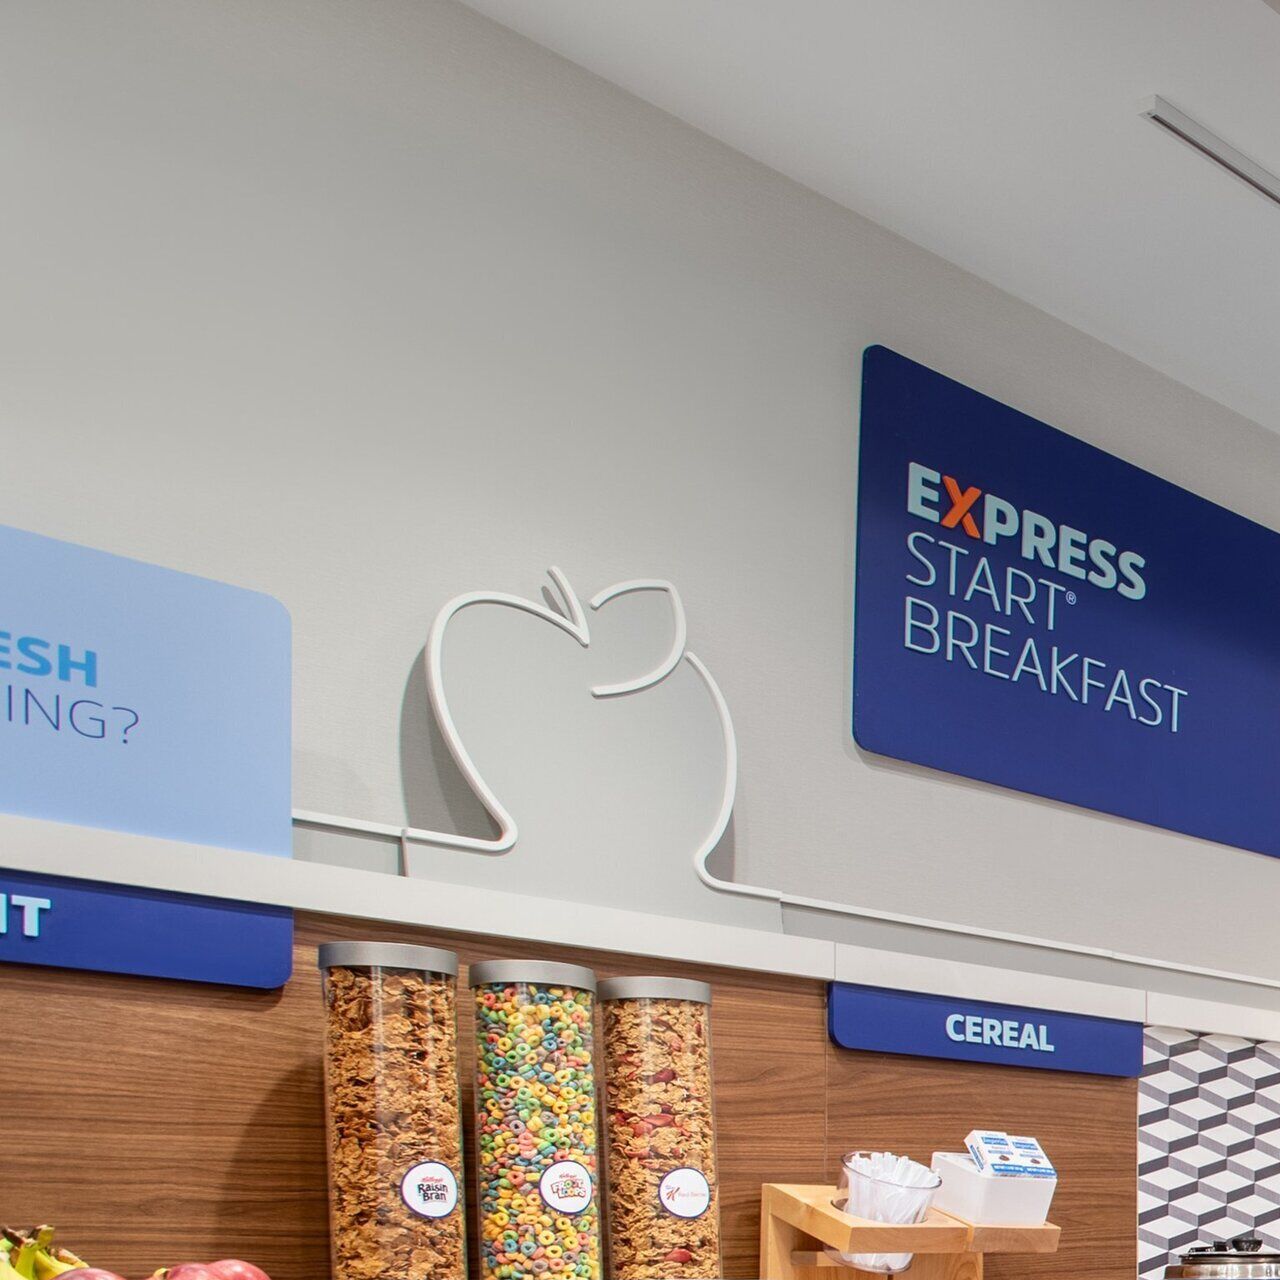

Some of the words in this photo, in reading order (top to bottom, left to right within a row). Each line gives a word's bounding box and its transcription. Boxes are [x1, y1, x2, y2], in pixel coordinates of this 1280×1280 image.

[907, 461, 1146, 600] EXPRESS
[904, 595, 1188, 733] BREAKFAST
[7, 684, 139, 744] ING?
[945, 1013, 1055, 1052] CEREAL
[417, 1183, 449, 1193] Raisin
[422, 1191, 447, 1201] Bran
